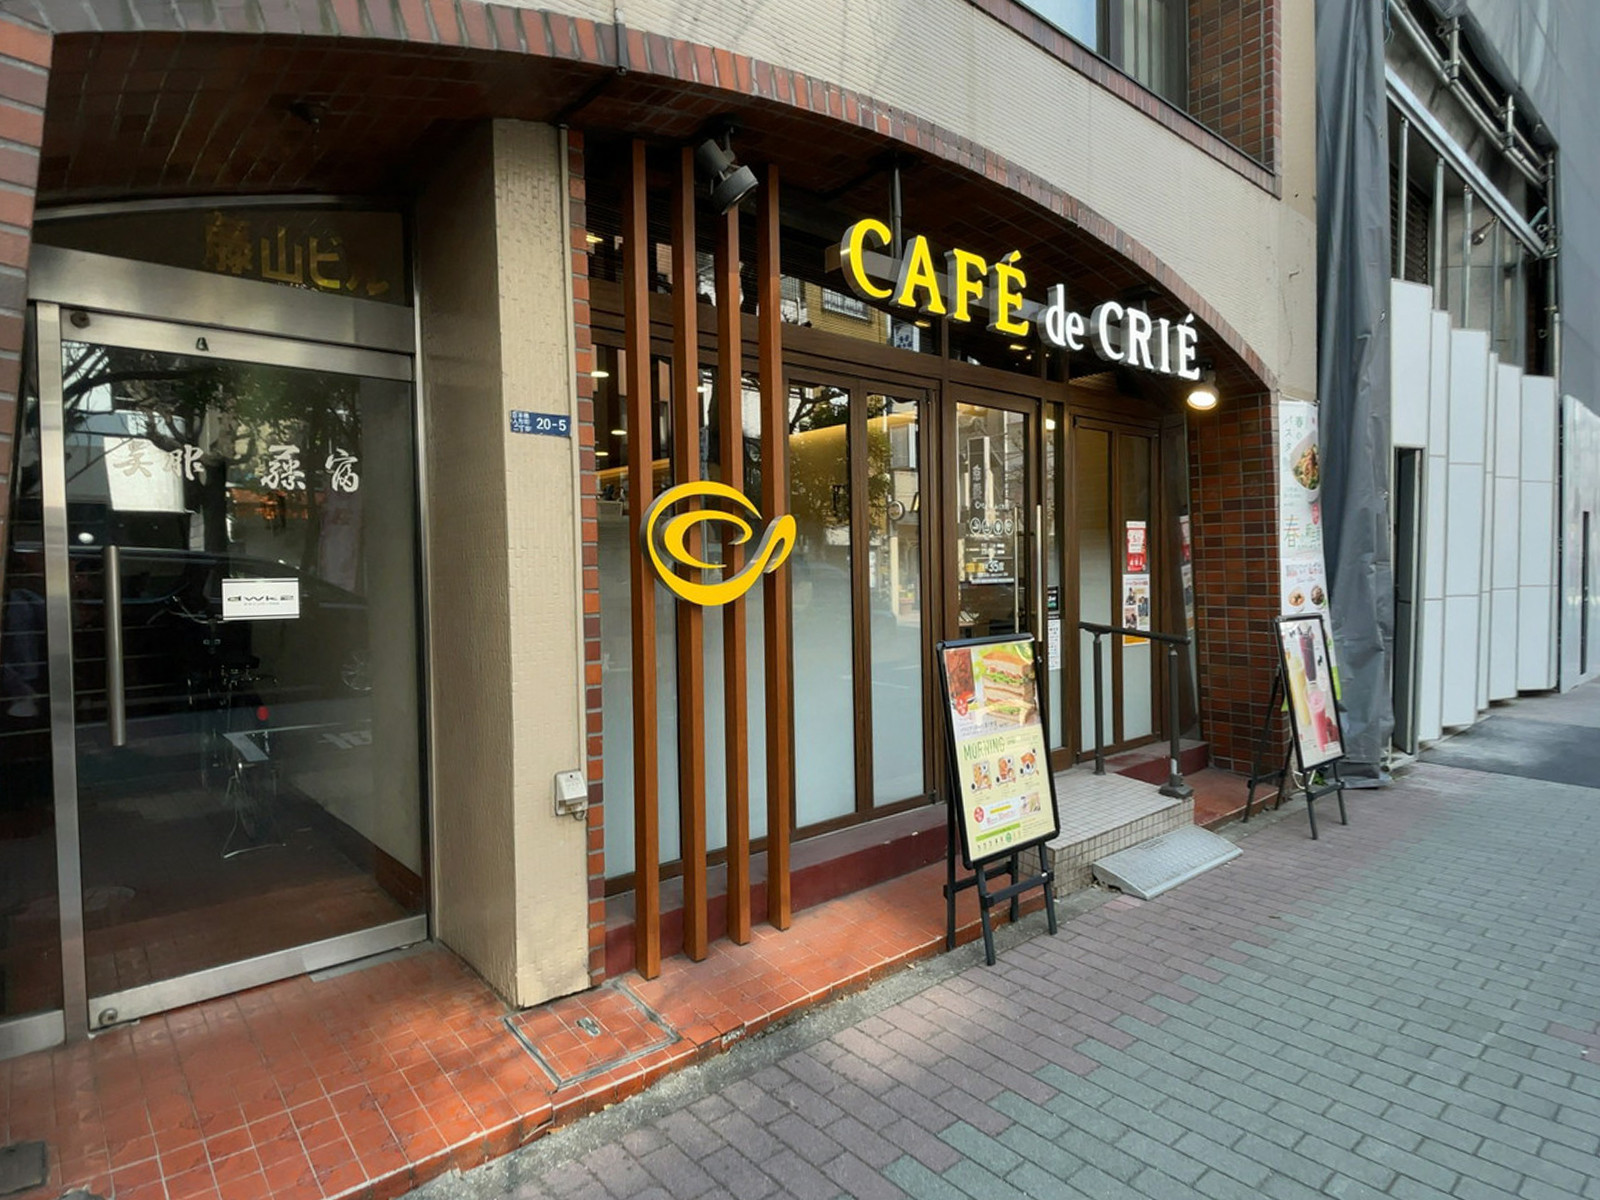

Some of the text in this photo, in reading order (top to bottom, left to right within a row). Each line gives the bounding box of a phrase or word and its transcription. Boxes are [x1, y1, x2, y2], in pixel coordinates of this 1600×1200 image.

[842, 218, 1200, 380] CAFÉ de CRIÉ
[536, 417, 567, 431] 20-5
[963, 736, 1006, 761] MORNING
